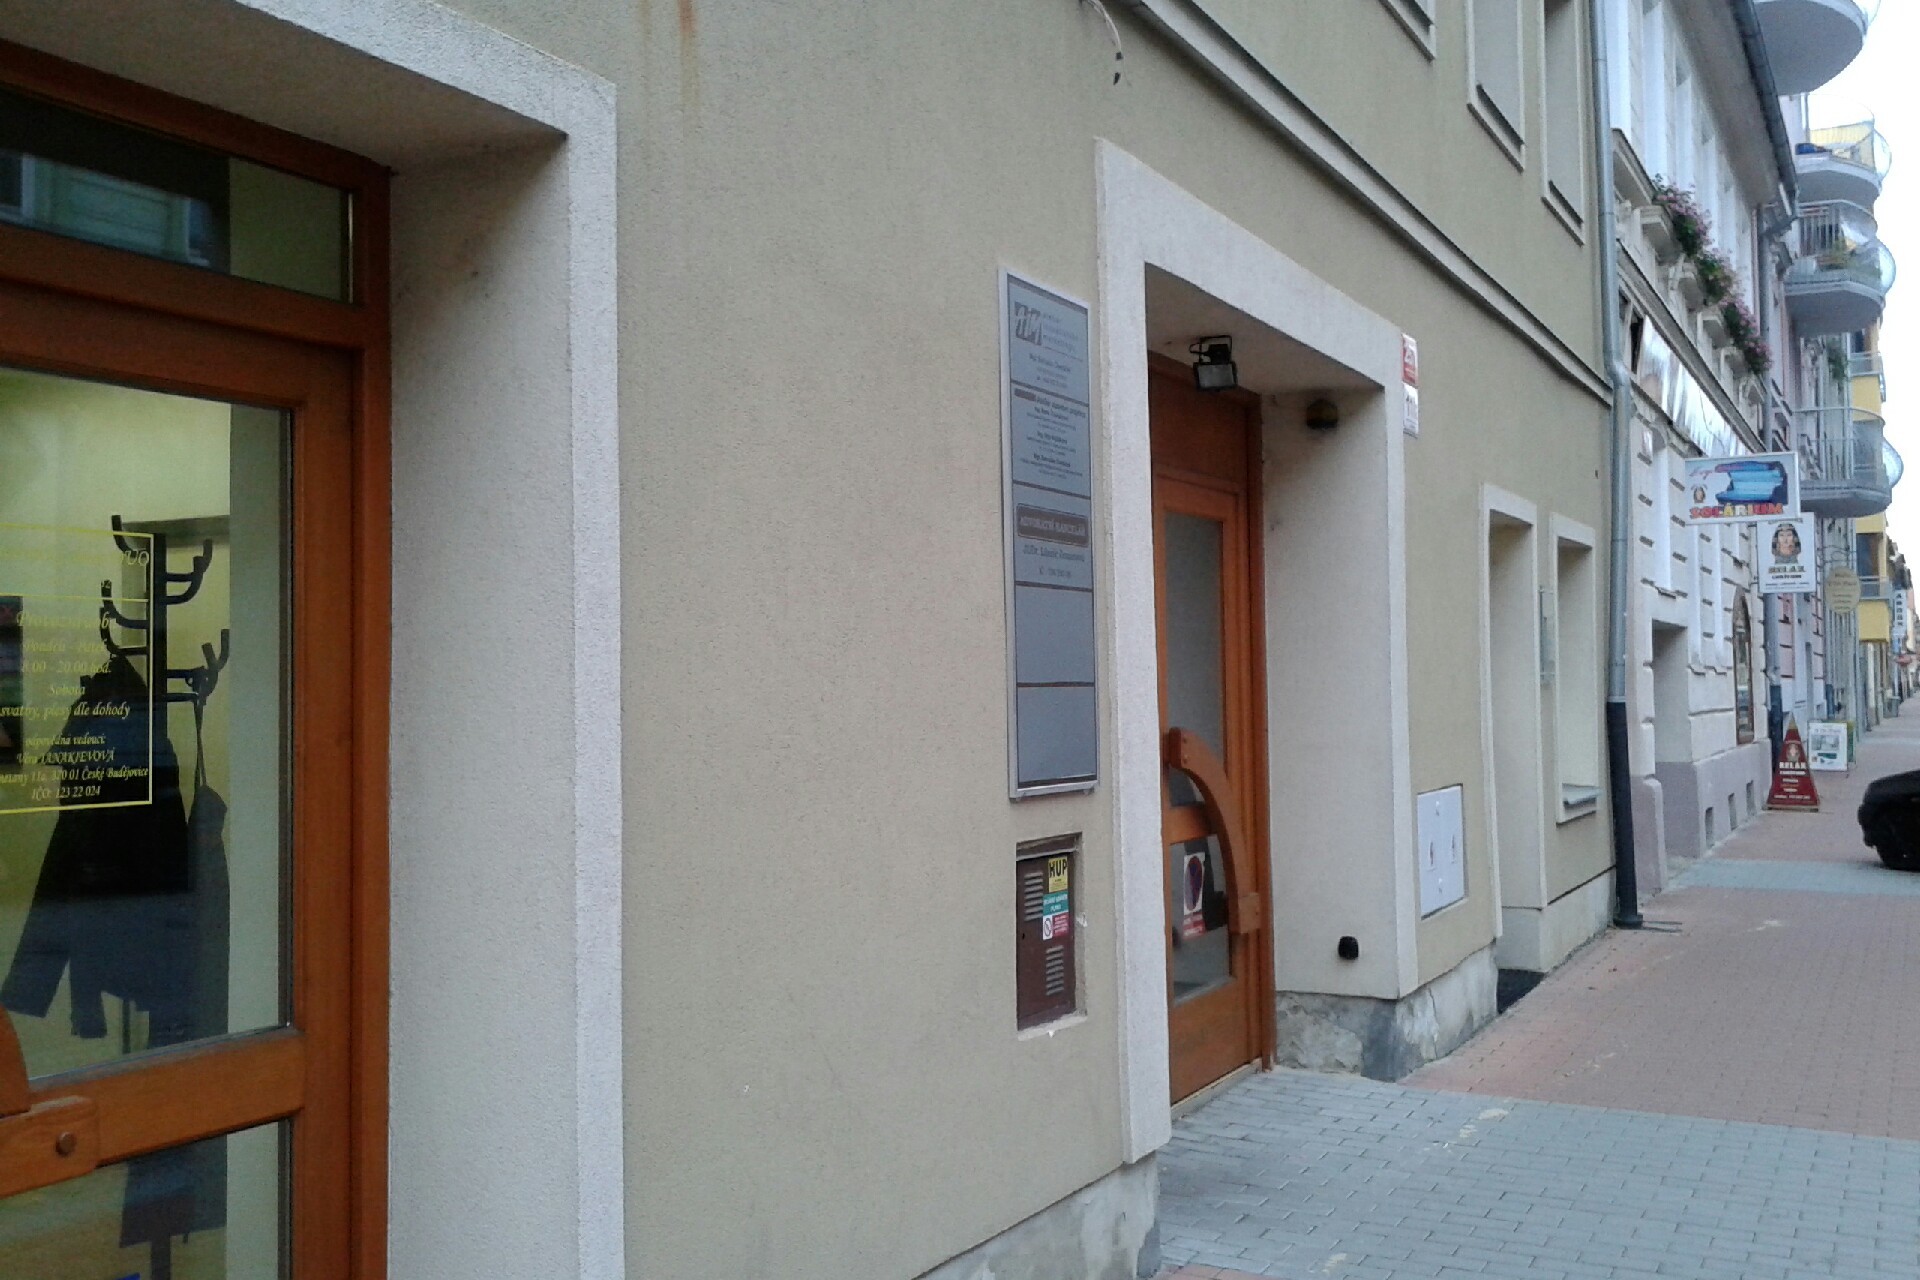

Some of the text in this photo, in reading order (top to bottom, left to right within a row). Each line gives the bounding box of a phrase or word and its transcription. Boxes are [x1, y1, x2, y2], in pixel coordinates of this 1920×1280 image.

[73, 701, 90, 716] dle
[92, 701, 131, 720] dohody
[1049, 858, 1067, 878] HUP
